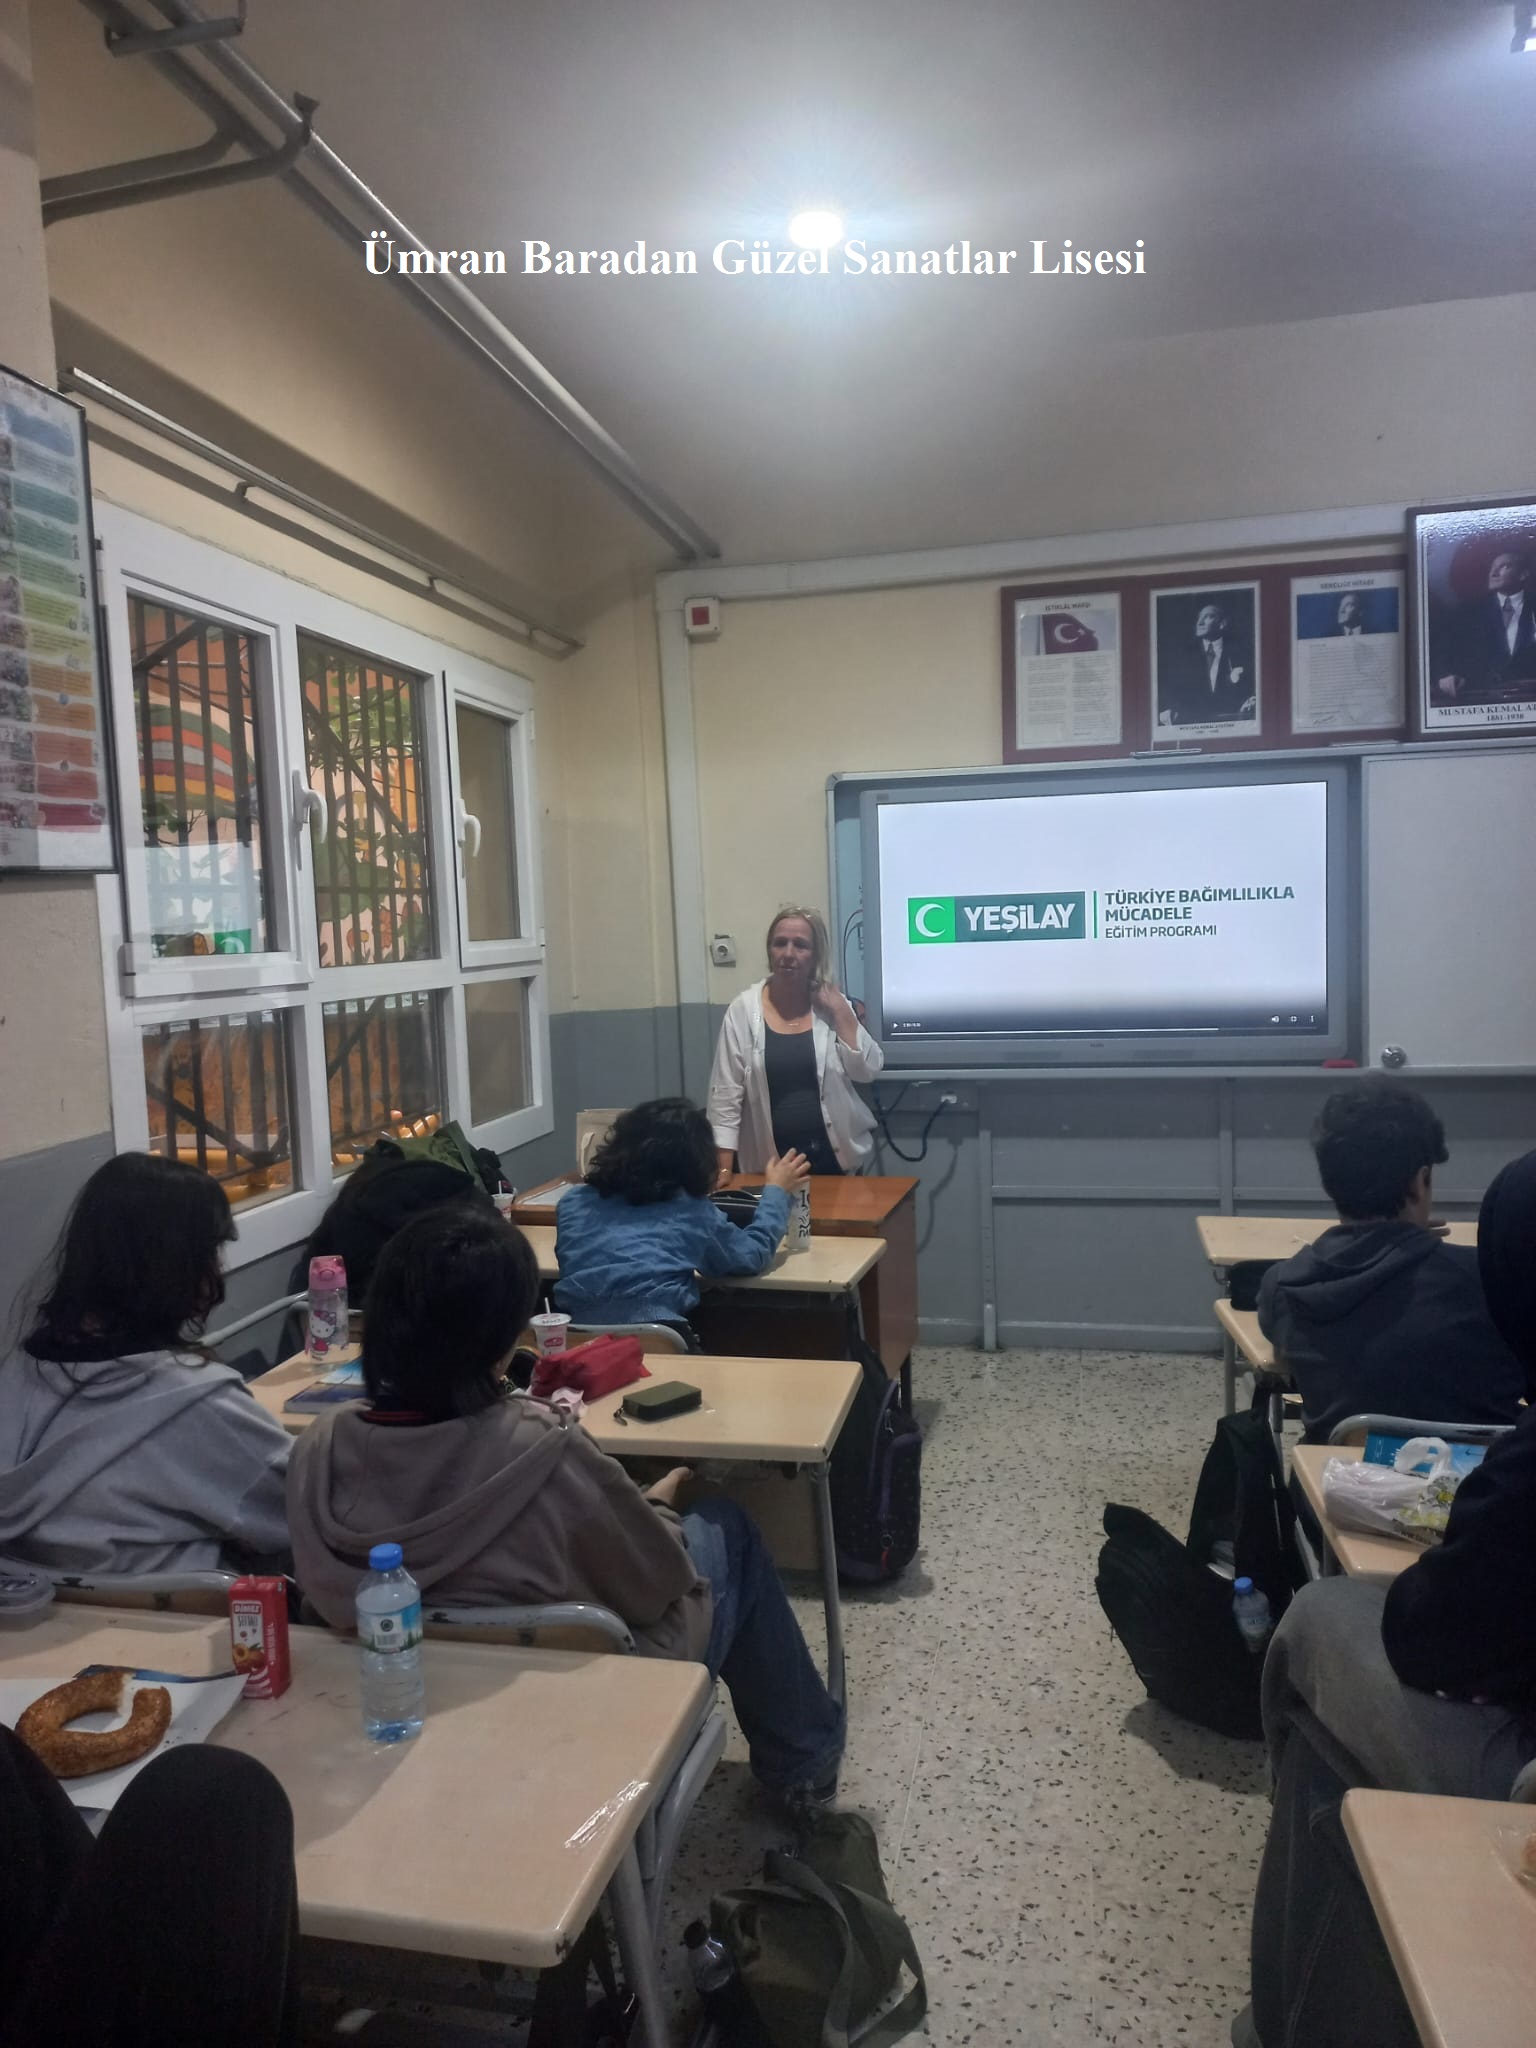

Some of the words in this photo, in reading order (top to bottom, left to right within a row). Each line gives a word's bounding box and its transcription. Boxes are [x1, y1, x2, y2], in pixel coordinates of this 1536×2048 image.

[1439, 707, 1485, 715] MUSTAFA
[1487, 704, 1521, 713] KEMAL
[1104, 888, 1175, 905] TÜRKİYE
[1178, 886, 1295, 903] BAĞIMLILIKLA
[1105, 906, 1192, 922] MÜCADELE
[1105, 925, 1147, 939] EĞİTİM
[1150, 924, 1217, 937] PROGRAMI
